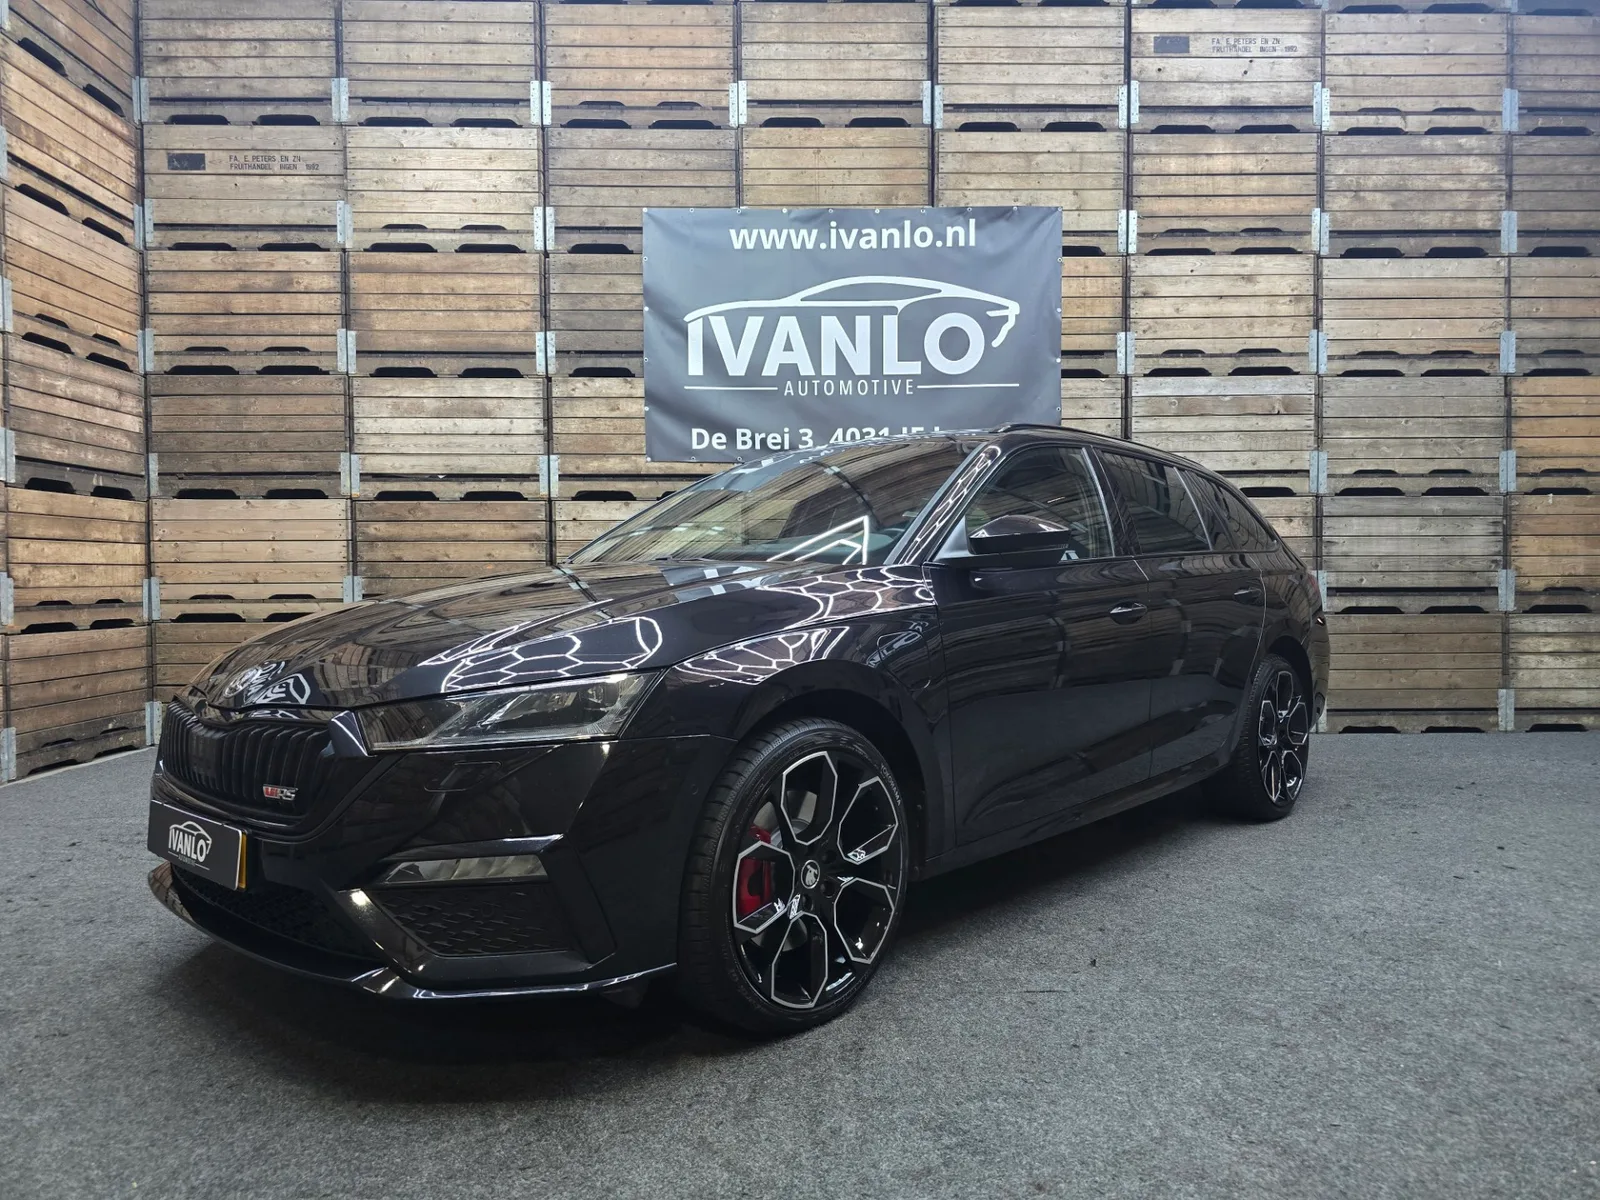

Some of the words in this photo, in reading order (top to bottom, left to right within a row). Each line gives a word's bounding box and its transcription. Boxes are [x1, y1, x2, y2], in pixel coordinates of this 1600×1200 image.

[1233, 37, 1257, 45] PETERS
[229, 163, 272, 171] FRUITHANDEL
[251, 155, 277, 163] PETERS
[280, 155, 289, 163] EN
[729, 218, 977, 250] www.ivanlo.nl
[687, 311, 985, 376] IVANLO
[783, 378, 914, 397] AUTOMOTIVE
[691, 428, 727, 450] De
[736, 427, 791, 450] Brei
[168, 827, 207, 863] IVANLO
